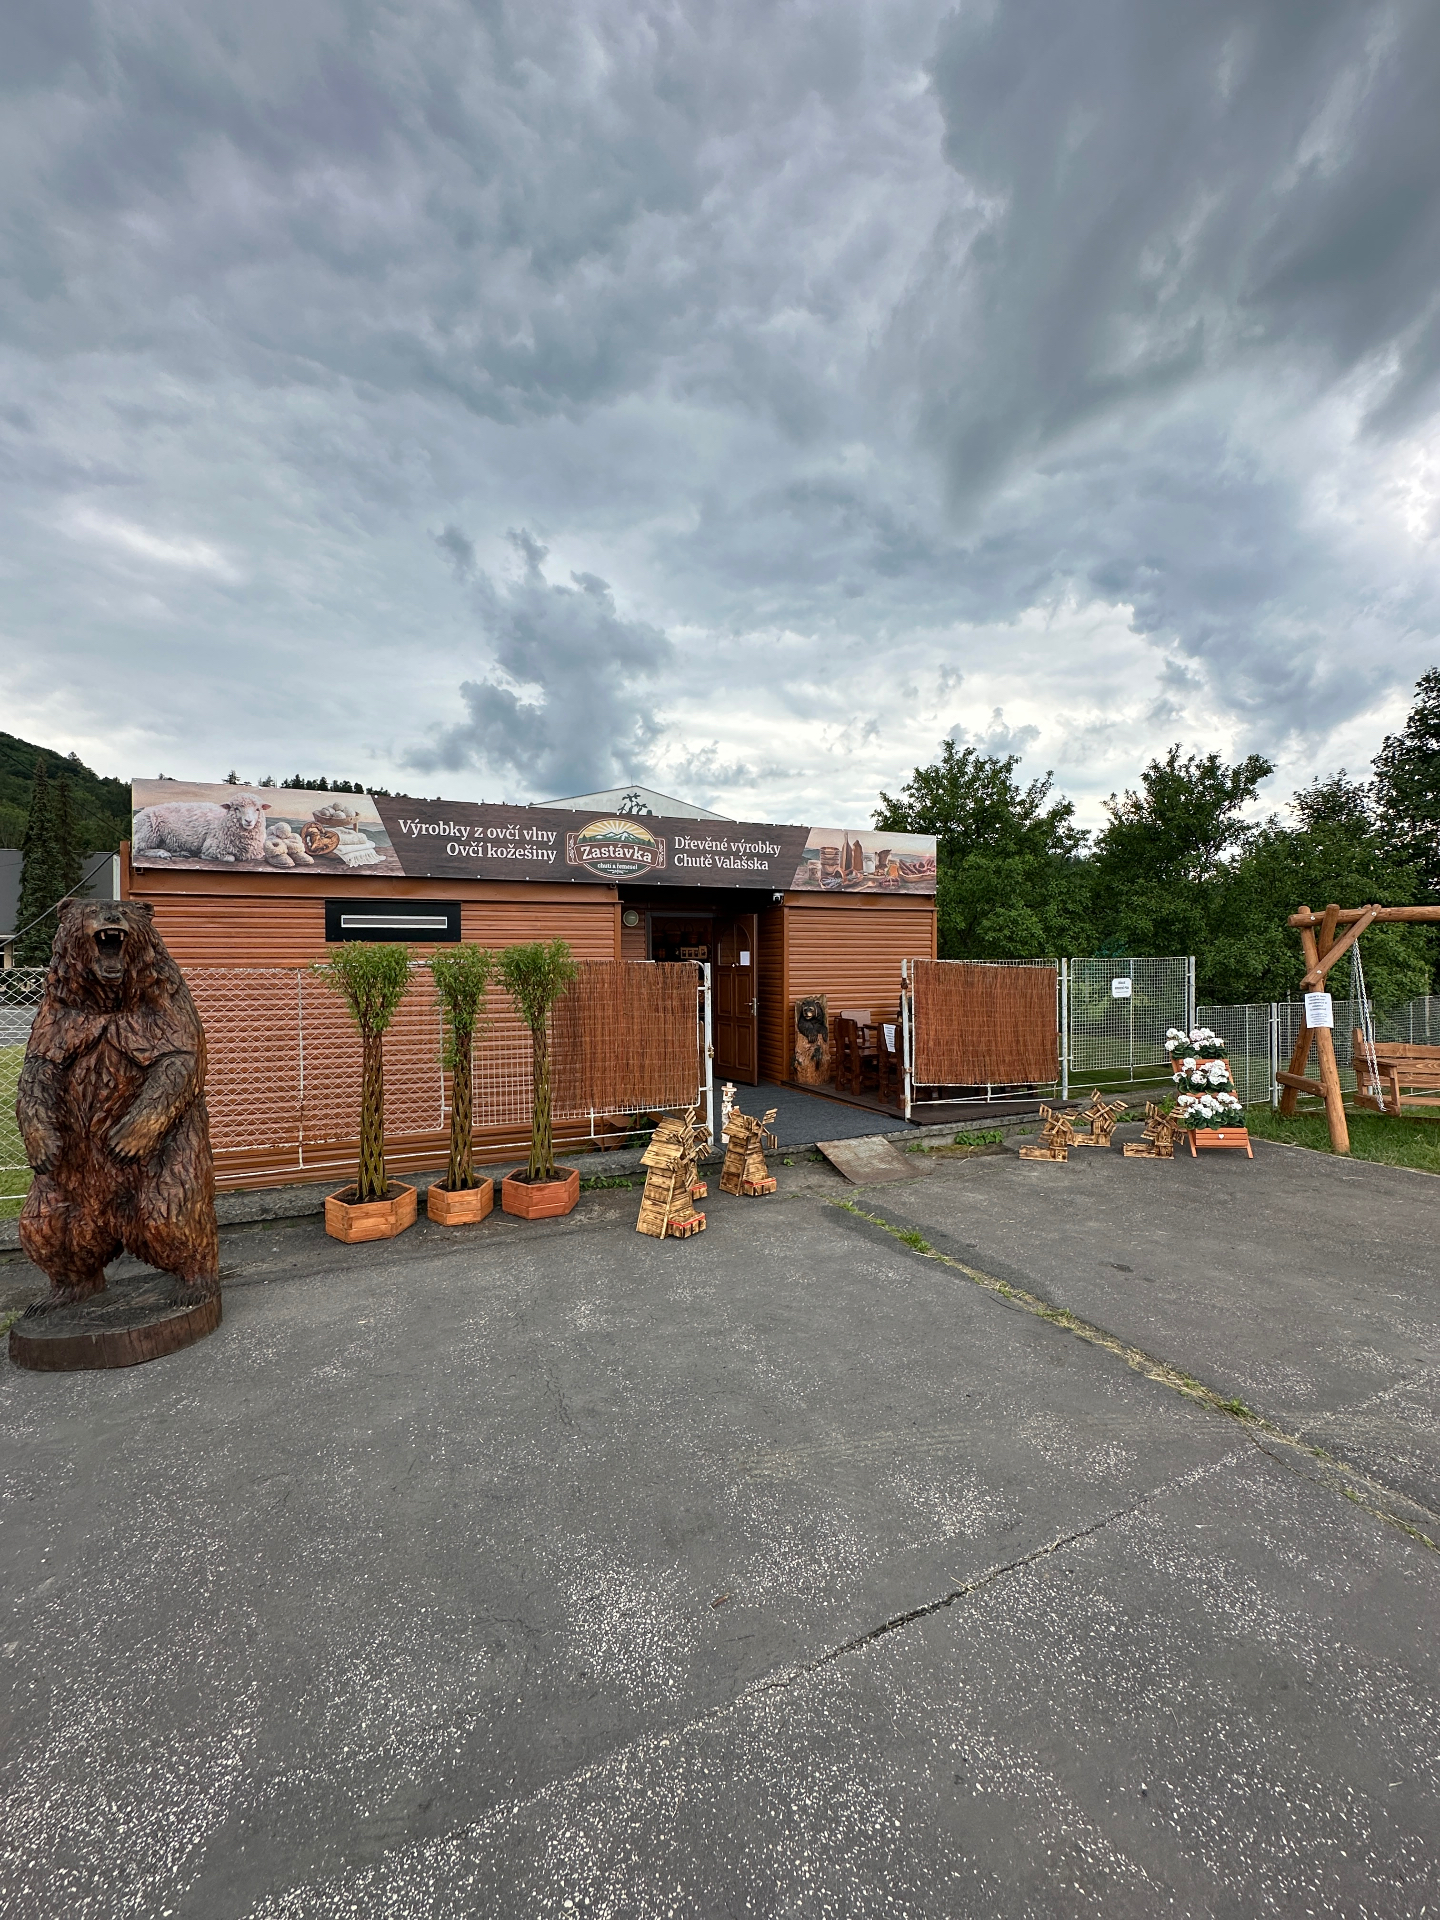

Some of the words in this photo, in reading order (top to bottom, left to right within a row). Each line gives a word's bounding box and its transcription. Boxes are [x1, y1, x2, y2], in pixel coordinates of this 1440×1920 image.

[398, 819, 471, 841] Výrobky
[474, 828, 483, 838] z
[486, 824, 520, 840] ovčí
[523, 826, 557, 845] vlny
[446, 841, 484, 857] Ovčí
[487, 843, 557, 863] kožešiny
[580, 844, 652, 863] Zastávka
[674, 836, 728, 851] Dřevěné
[730, 840, 781, 858] výrobky
[674, 854, 713, 868] Chutě
[715, 856, 769, 871] Valašska
